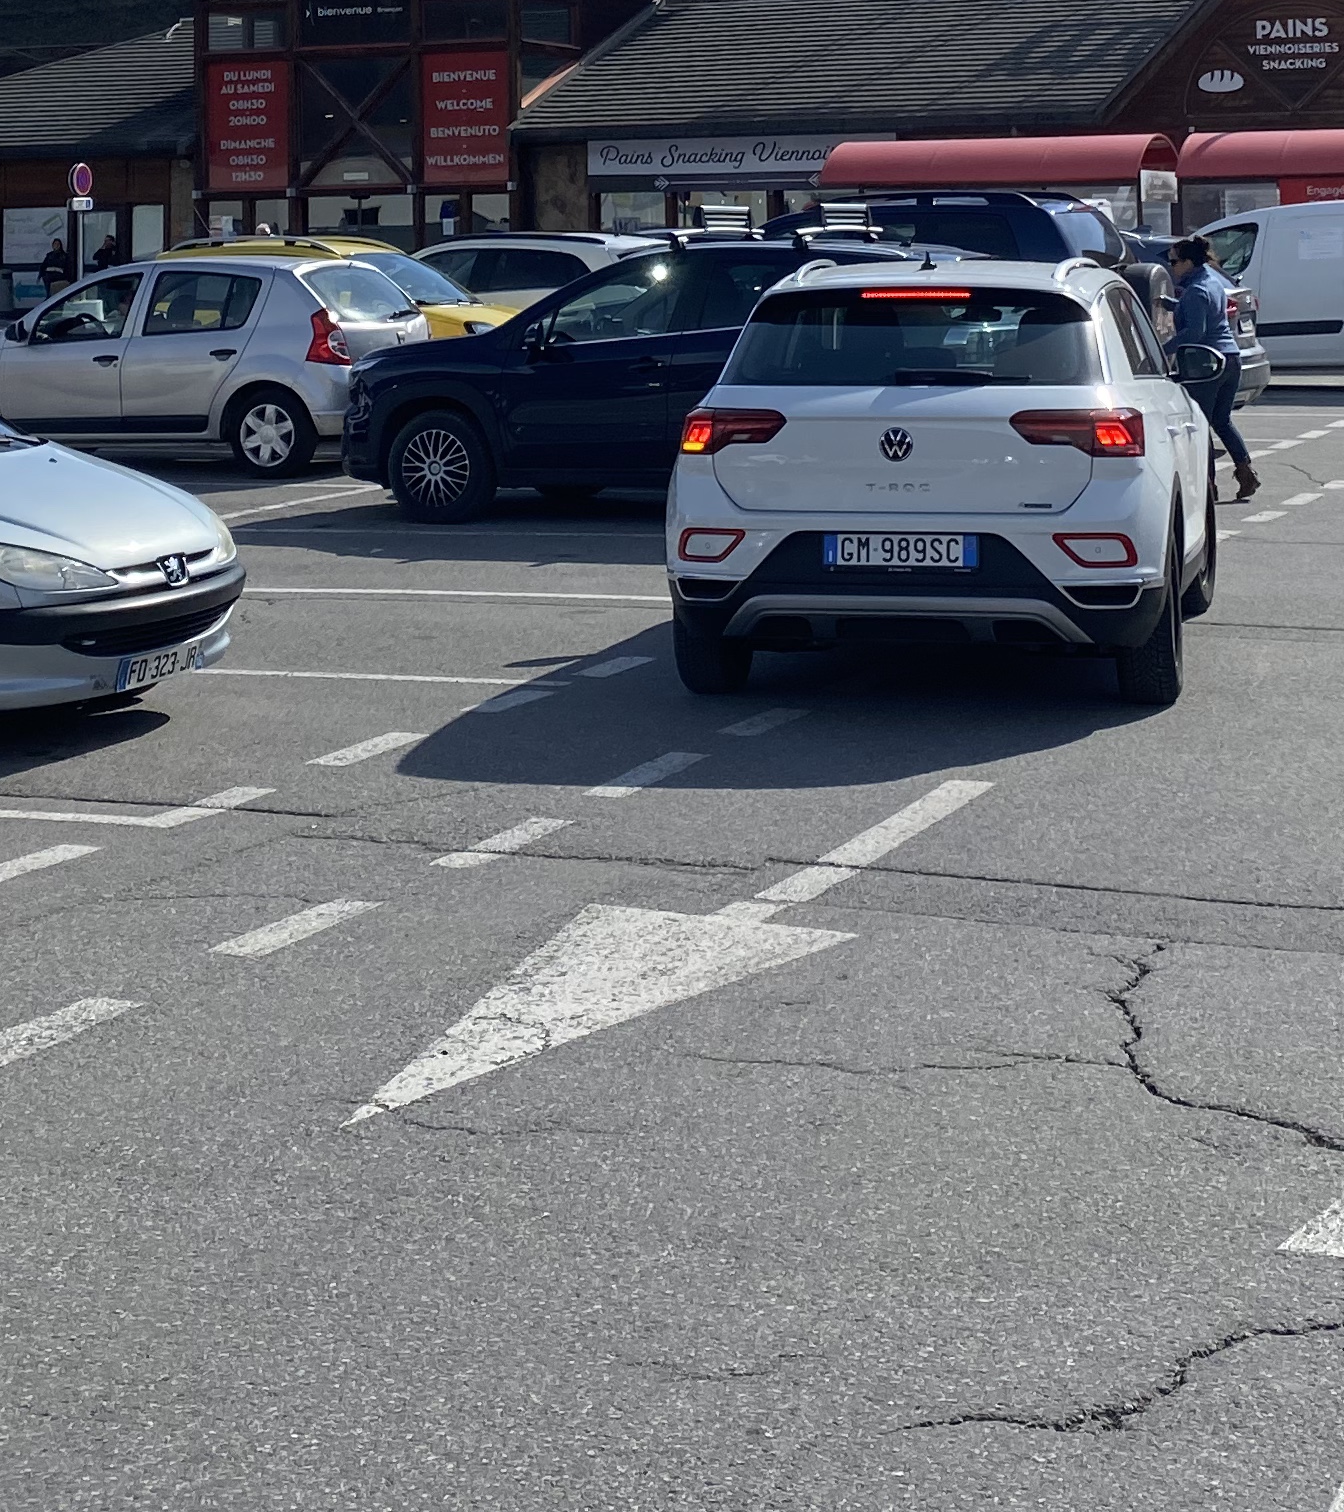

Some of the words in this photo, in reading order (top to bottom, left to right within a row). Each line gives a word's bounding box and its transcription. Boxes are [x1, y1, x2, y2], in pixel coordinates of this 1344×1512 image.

[317, 7, 372, 17] bienvenue
[1256, 18, 1329, 39] PAINS
[1248, 43, 1339, 55] VIENNOISERIES
[1262, 58, 1326, 70] SNACKING
[224, 71, 237, 81] DU
[240, 70, 271, 80] LUNDI
[432, 70, 496, 82] BIENVENUE
[220, 85, 234, 94] AU
[237, 83, 274, 94] SAMEDI
[229, 99, 266, 110] 08H30
[436, 98, 493, 110] WELCOME
[228, 115, 267, 126] 20H00
[430, 126, 499, 138] BENVENUTO
[220, 138, 275, 149] DIMANCHE
[229, 155, 266, 165] 08H30
[426, 154, 504, 165] WILLKOMMEN
[600, 145, 653, 166] Pains
[660, 144, 746, 169] Snacking
[752, 141, 835, 163] Viennoi
[232, 172, 264, 181] 12H30
[865, 483, 931, 493] T-ROC
